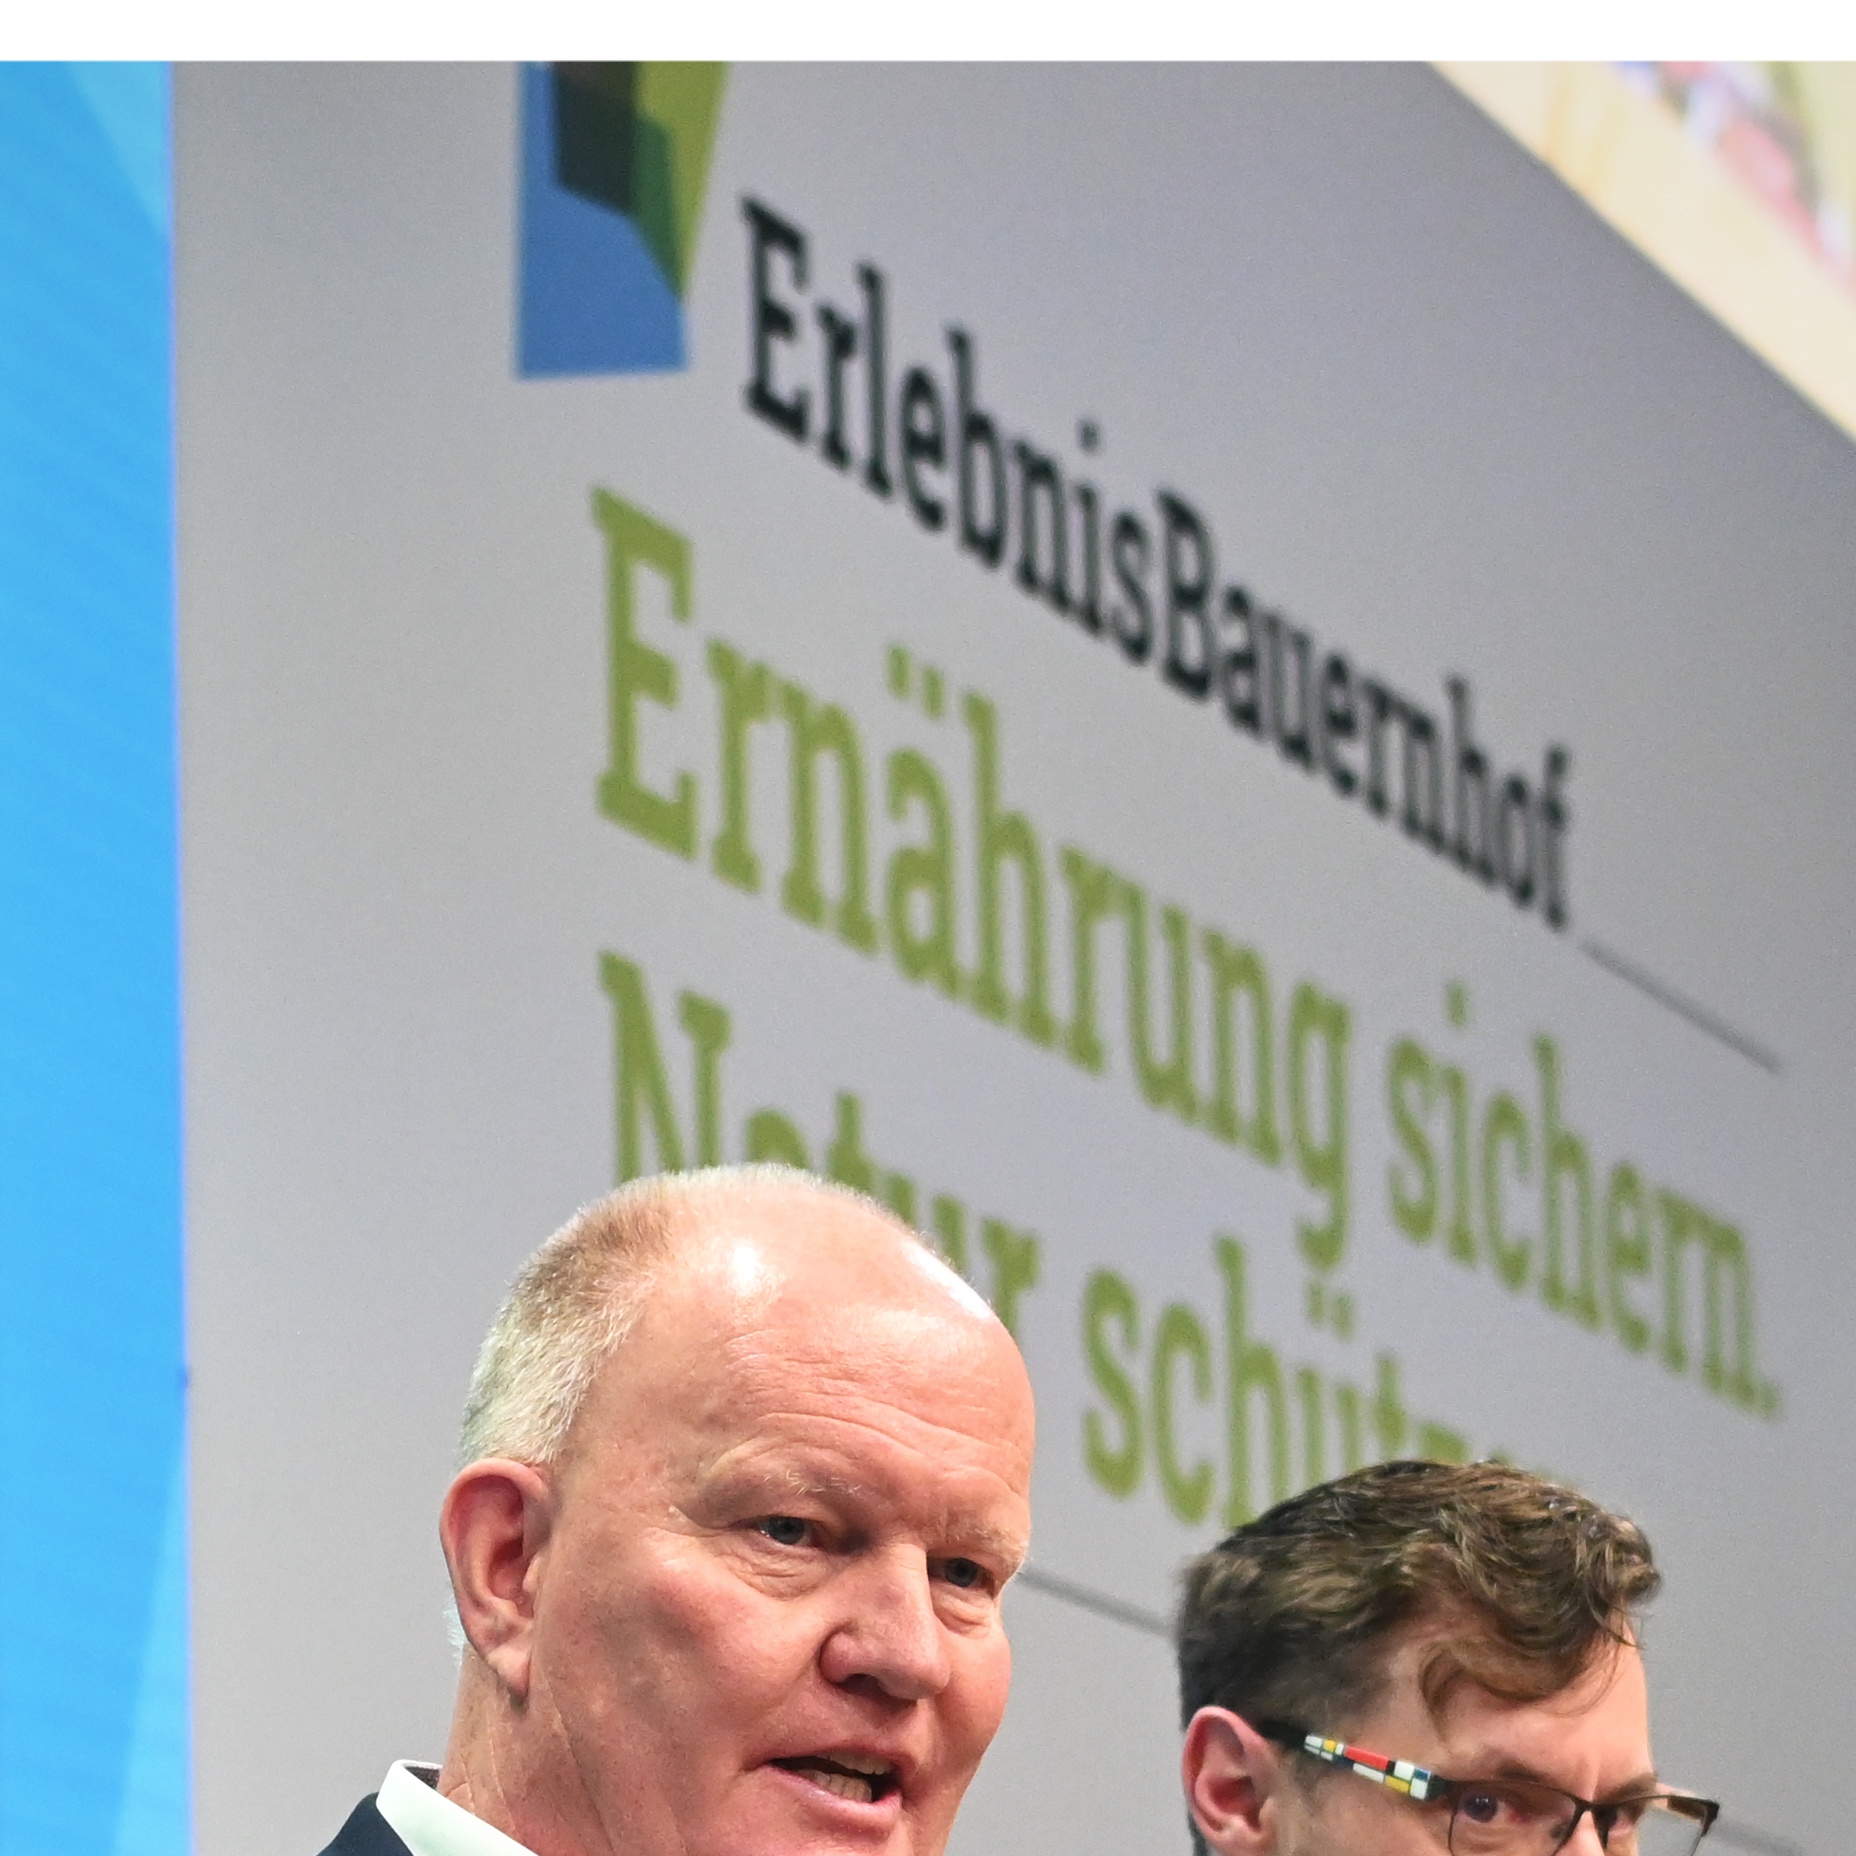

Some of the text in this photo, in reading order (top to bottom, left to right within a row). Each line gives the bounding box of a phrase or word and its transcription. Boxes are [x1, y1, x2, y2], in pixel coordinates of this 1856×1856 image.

[590, 485, 1781, 1418] Ernährung sichern.
[740, 190, 1574, 934] ErlebnisBauernhof
